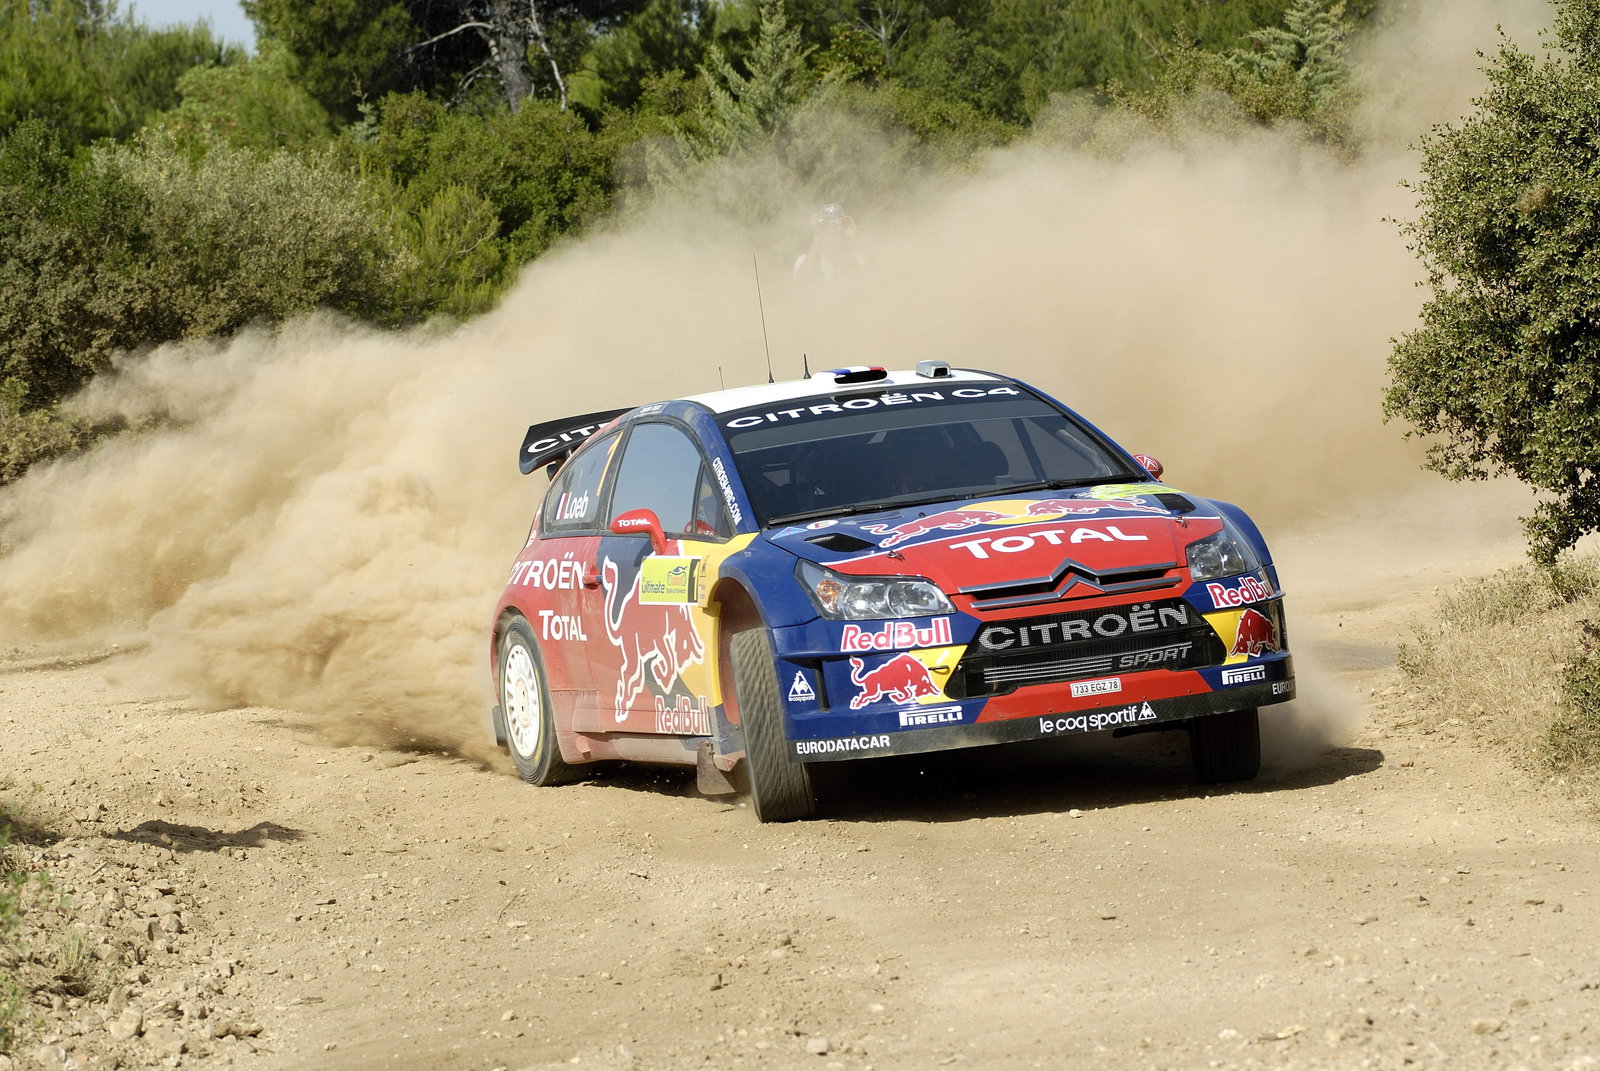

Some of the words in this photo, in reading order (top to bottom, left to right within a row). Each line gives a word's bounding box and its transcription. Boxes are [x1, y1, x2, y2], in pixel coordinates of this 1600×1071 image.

[726, 391, 945, 428] CITROËN
[951, 386, 1020, 399] C4
[563, 489, 589, 520] Loeb
[617, 518, 651, 527] TOTAL
[949, 525, 1149, 559] TOTAL
[538, 610, 587, 641] TOTAL
[840, 621, 895, 652] Red
[895, 617, 952, 648] Bull
[978, 602, 1189, 650] CITROËN
[1118, 647, 1191, 668] SPORT
[1074, 685, 1089, 694] 733
[1090, 682, 1107, 692] EGZ
[1108, 681, 1118, 690] 78
[1221, 665, 1265, 685] PIRELLI
[655, 694, 682, 733] Red
[682, 695, 711, 734] Bull
[899, 706, 963, 726] PIRELLI
[1039, 718, 1054, 733] le
[1056, 716, 1088, 732] coq
[1089, 706, 1137, 730] sportif
[796, 736, 890, 754] EURODATACAR
